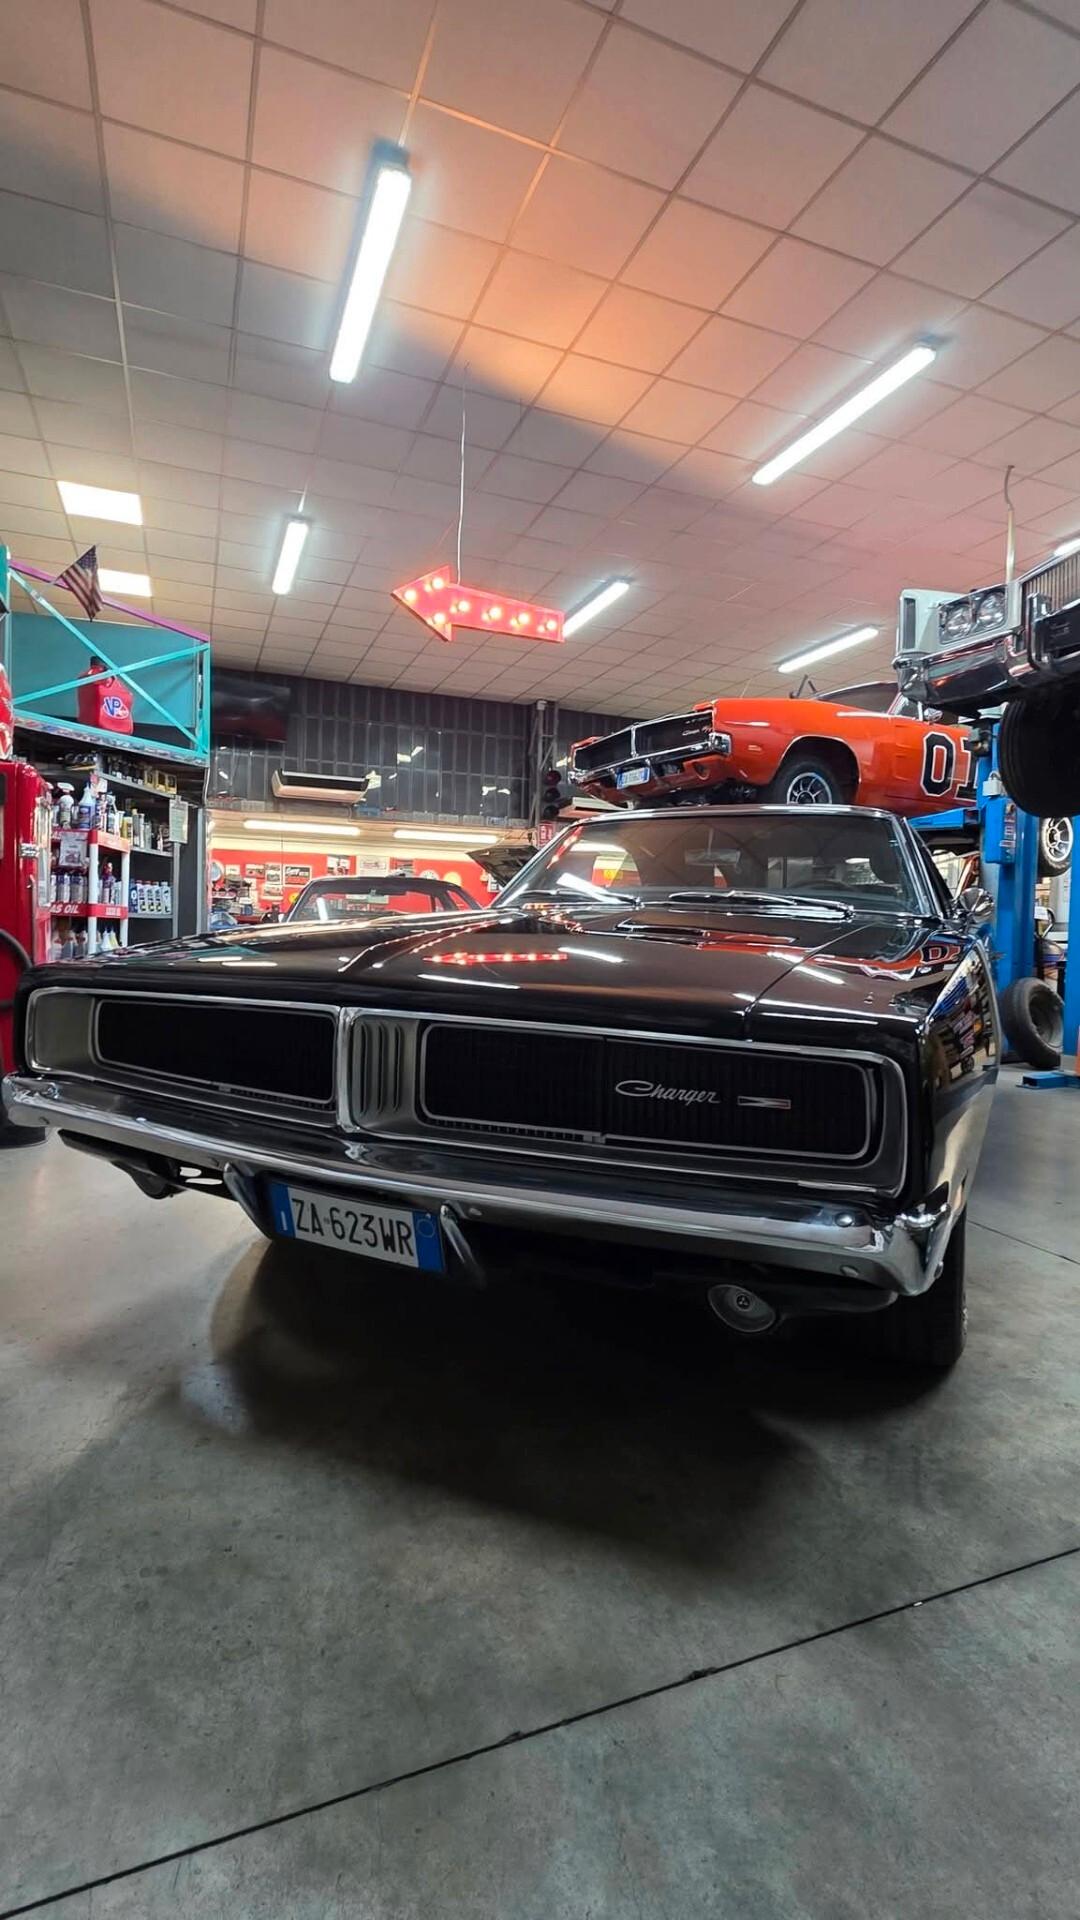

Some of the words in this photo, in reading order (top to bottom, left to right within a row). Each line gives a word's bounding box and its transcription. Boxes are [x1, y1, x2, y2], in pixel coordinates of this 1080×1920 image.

[105, 698, 121, 716] VP
[920, 731, 979, 802] 01
[64, 904, 80, 914] OIL
[615, 1079, 722, 1106] Charger
[329, 1206, 414, 1257] 623WR
